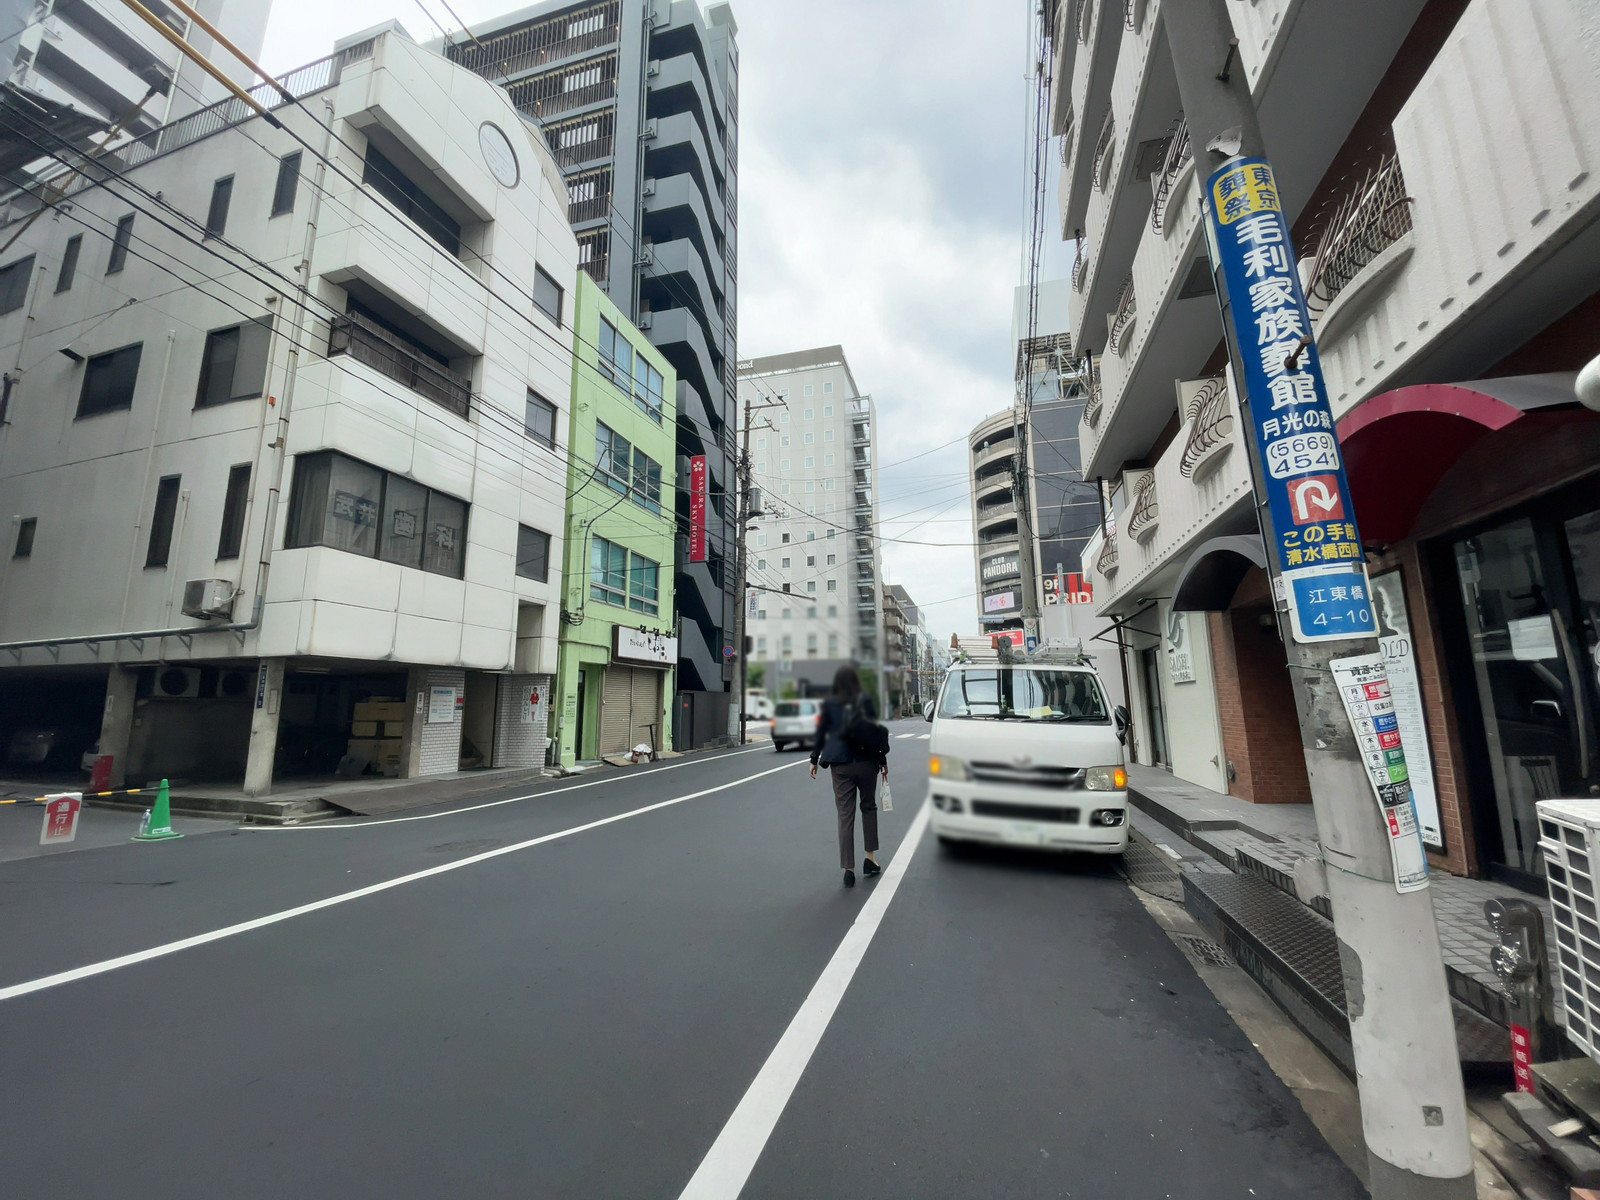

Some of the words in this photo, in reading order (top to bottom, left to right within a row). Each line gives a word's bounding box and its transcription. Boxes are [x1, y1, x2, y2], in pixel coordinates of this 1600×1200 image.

[1218, 169, 1251, 222] 葬祭
[1251, 166, 1280, 210] 東京
[1235, 213, 1318, 411] 毛利家族葬館
[1262, 409, 1333, 441] 月光の森
[1270, 434, 1334, 460] (5669)
[1274, 451, 1338, 475] 4541
[1283, 522, 1357, 548] この手前
[983, 561, 1018, 579] PANDORA
[1308, 585, 1364, 604] 江東橋
[1313, 608, 1370, 627] 4-10
